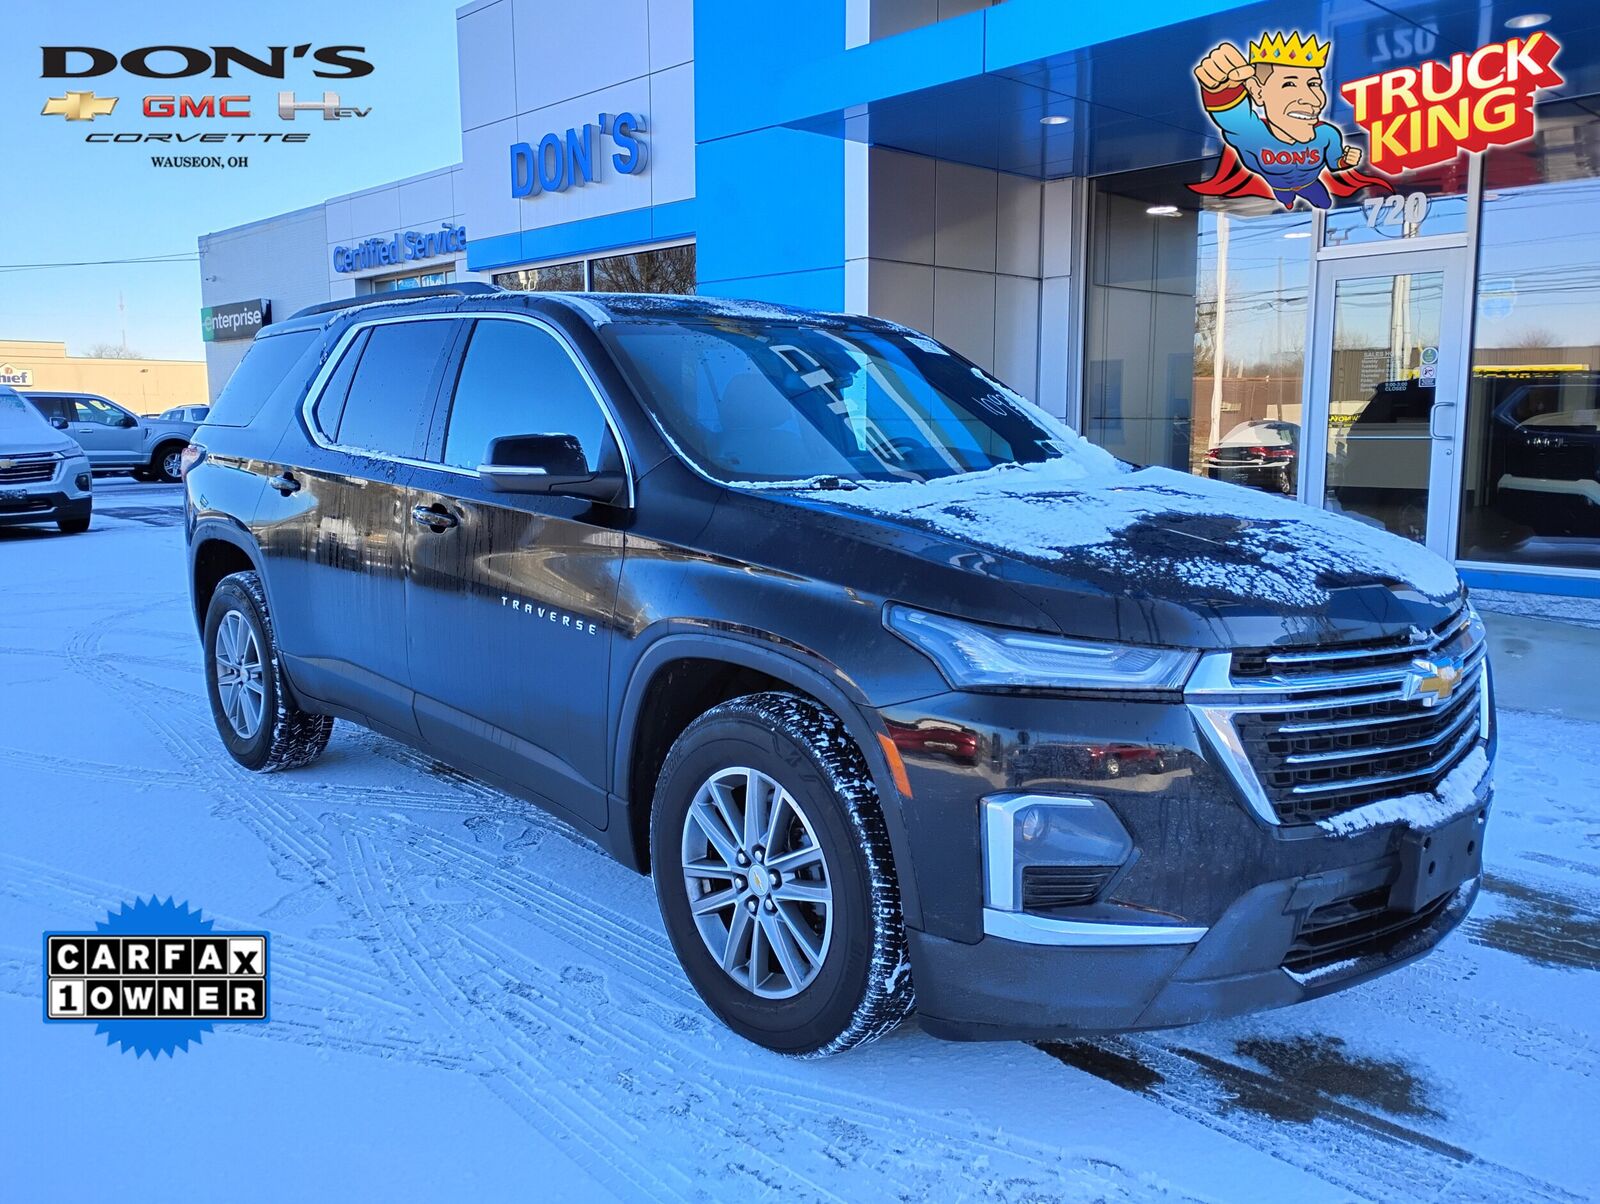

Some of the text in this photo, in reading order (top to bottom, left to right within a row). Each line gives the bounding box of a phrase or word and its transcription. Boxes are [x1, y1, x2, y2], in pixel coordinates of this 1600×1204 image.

[510, 112, 648, 200] DON'S
[1365, 192, 1428, 228] 720
[333, 222, 467, 273] Certified Service
[205, 307, 262, 332] enterprise
[501, 596, 597, 635] TRAVERSE
